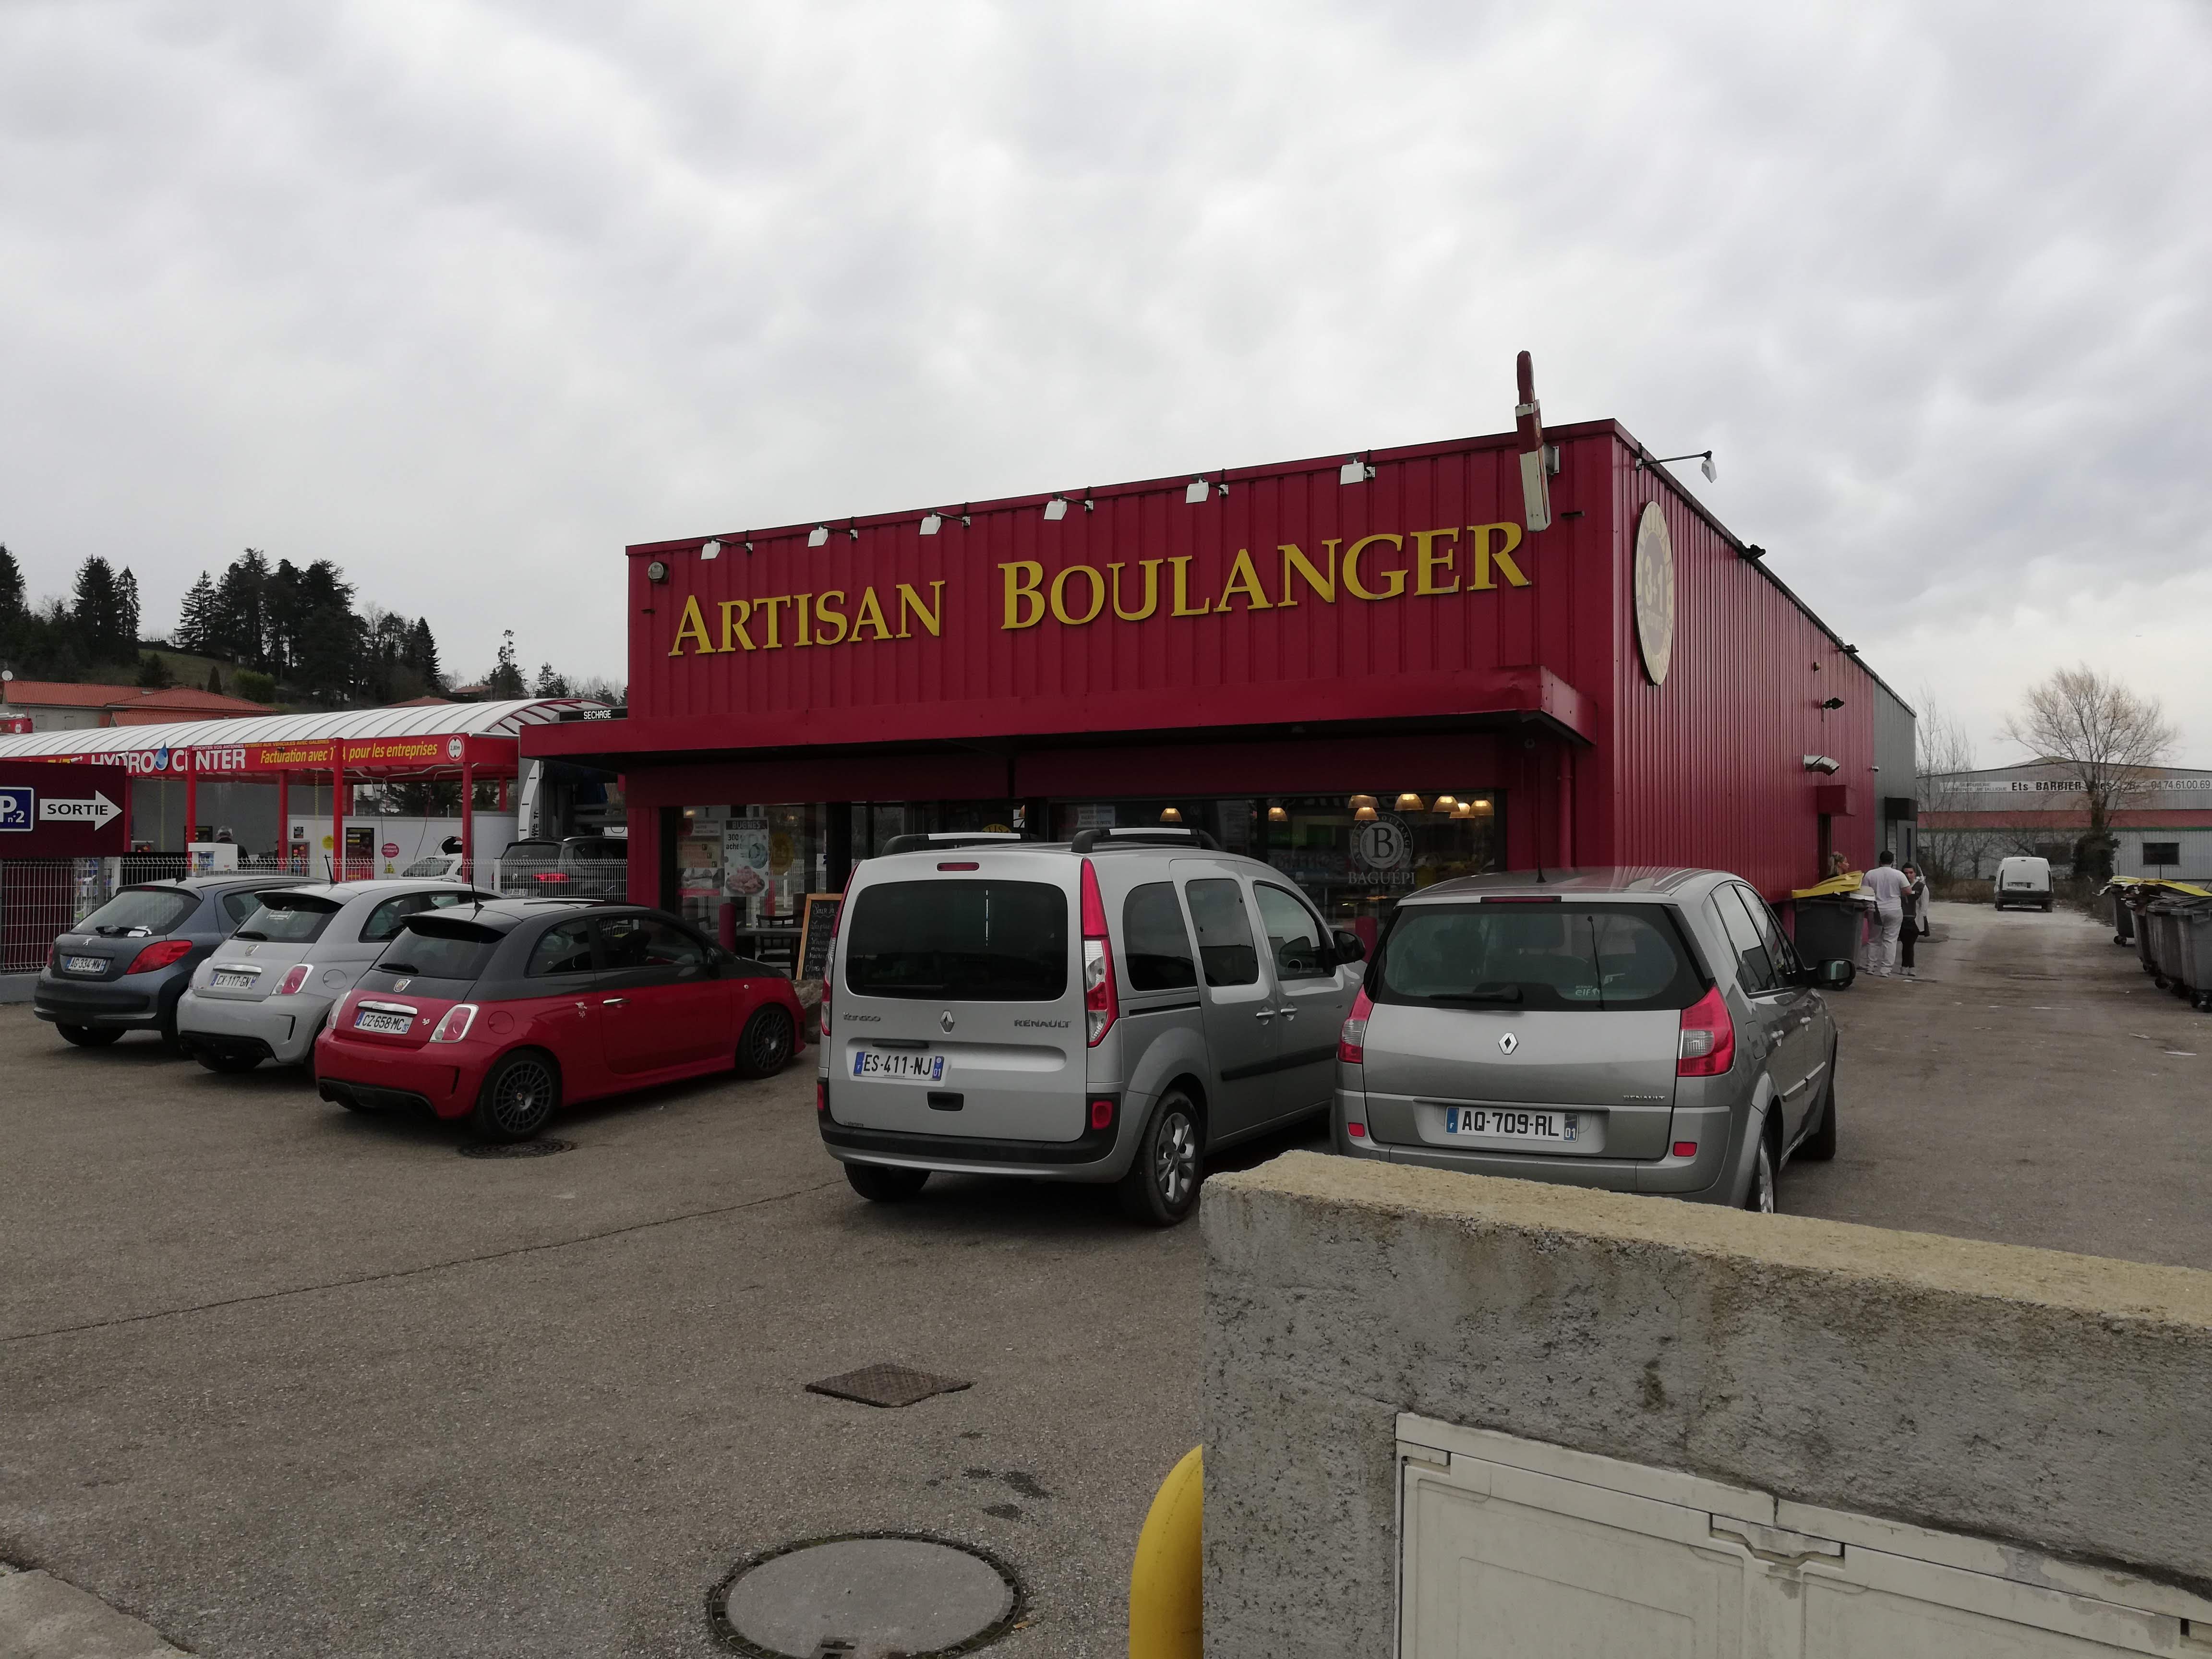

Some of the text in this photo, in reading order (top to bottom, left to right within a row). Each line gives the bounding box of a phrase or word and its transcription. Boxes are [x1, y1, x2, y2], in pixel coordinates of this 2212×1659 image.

[669, 522, 1531, 656] ARTISAN BOULANGER
[583, 709, 612, 720] SECHAGE
[172, 749, 246, 772] CNTER
[261, 748, 307, 764] Facturation
[308, 750, 328, 762] avec
[348, 746, 371, 762] pour
[372, 743, 385, 758] les
[386, 741, 438, 760] entreprises
[2011, 782, 2029, 791] Ets
[2036, 781, 2081, 791] BARBIER
[0, 796, 17, 823] P
[48, 804, 108, 815] SORTIE
[732, 821, 761, 830] BUGNES
[1371, 828, 1394, 858] B
[216, 975, 251, 987] CX-117-GN
[362, 1015, 404, 1030] CZ-658-MC
[1014, 1019, 1072, 1028] RENAULT
[863, 1054, 932, 1075] ES-411-NJ
[933, 1068, 941, 1077] 01
[1462, 1110, 1559, 1137] AQ-709-RL
[1564, 1128, 1576, 1139] 01
